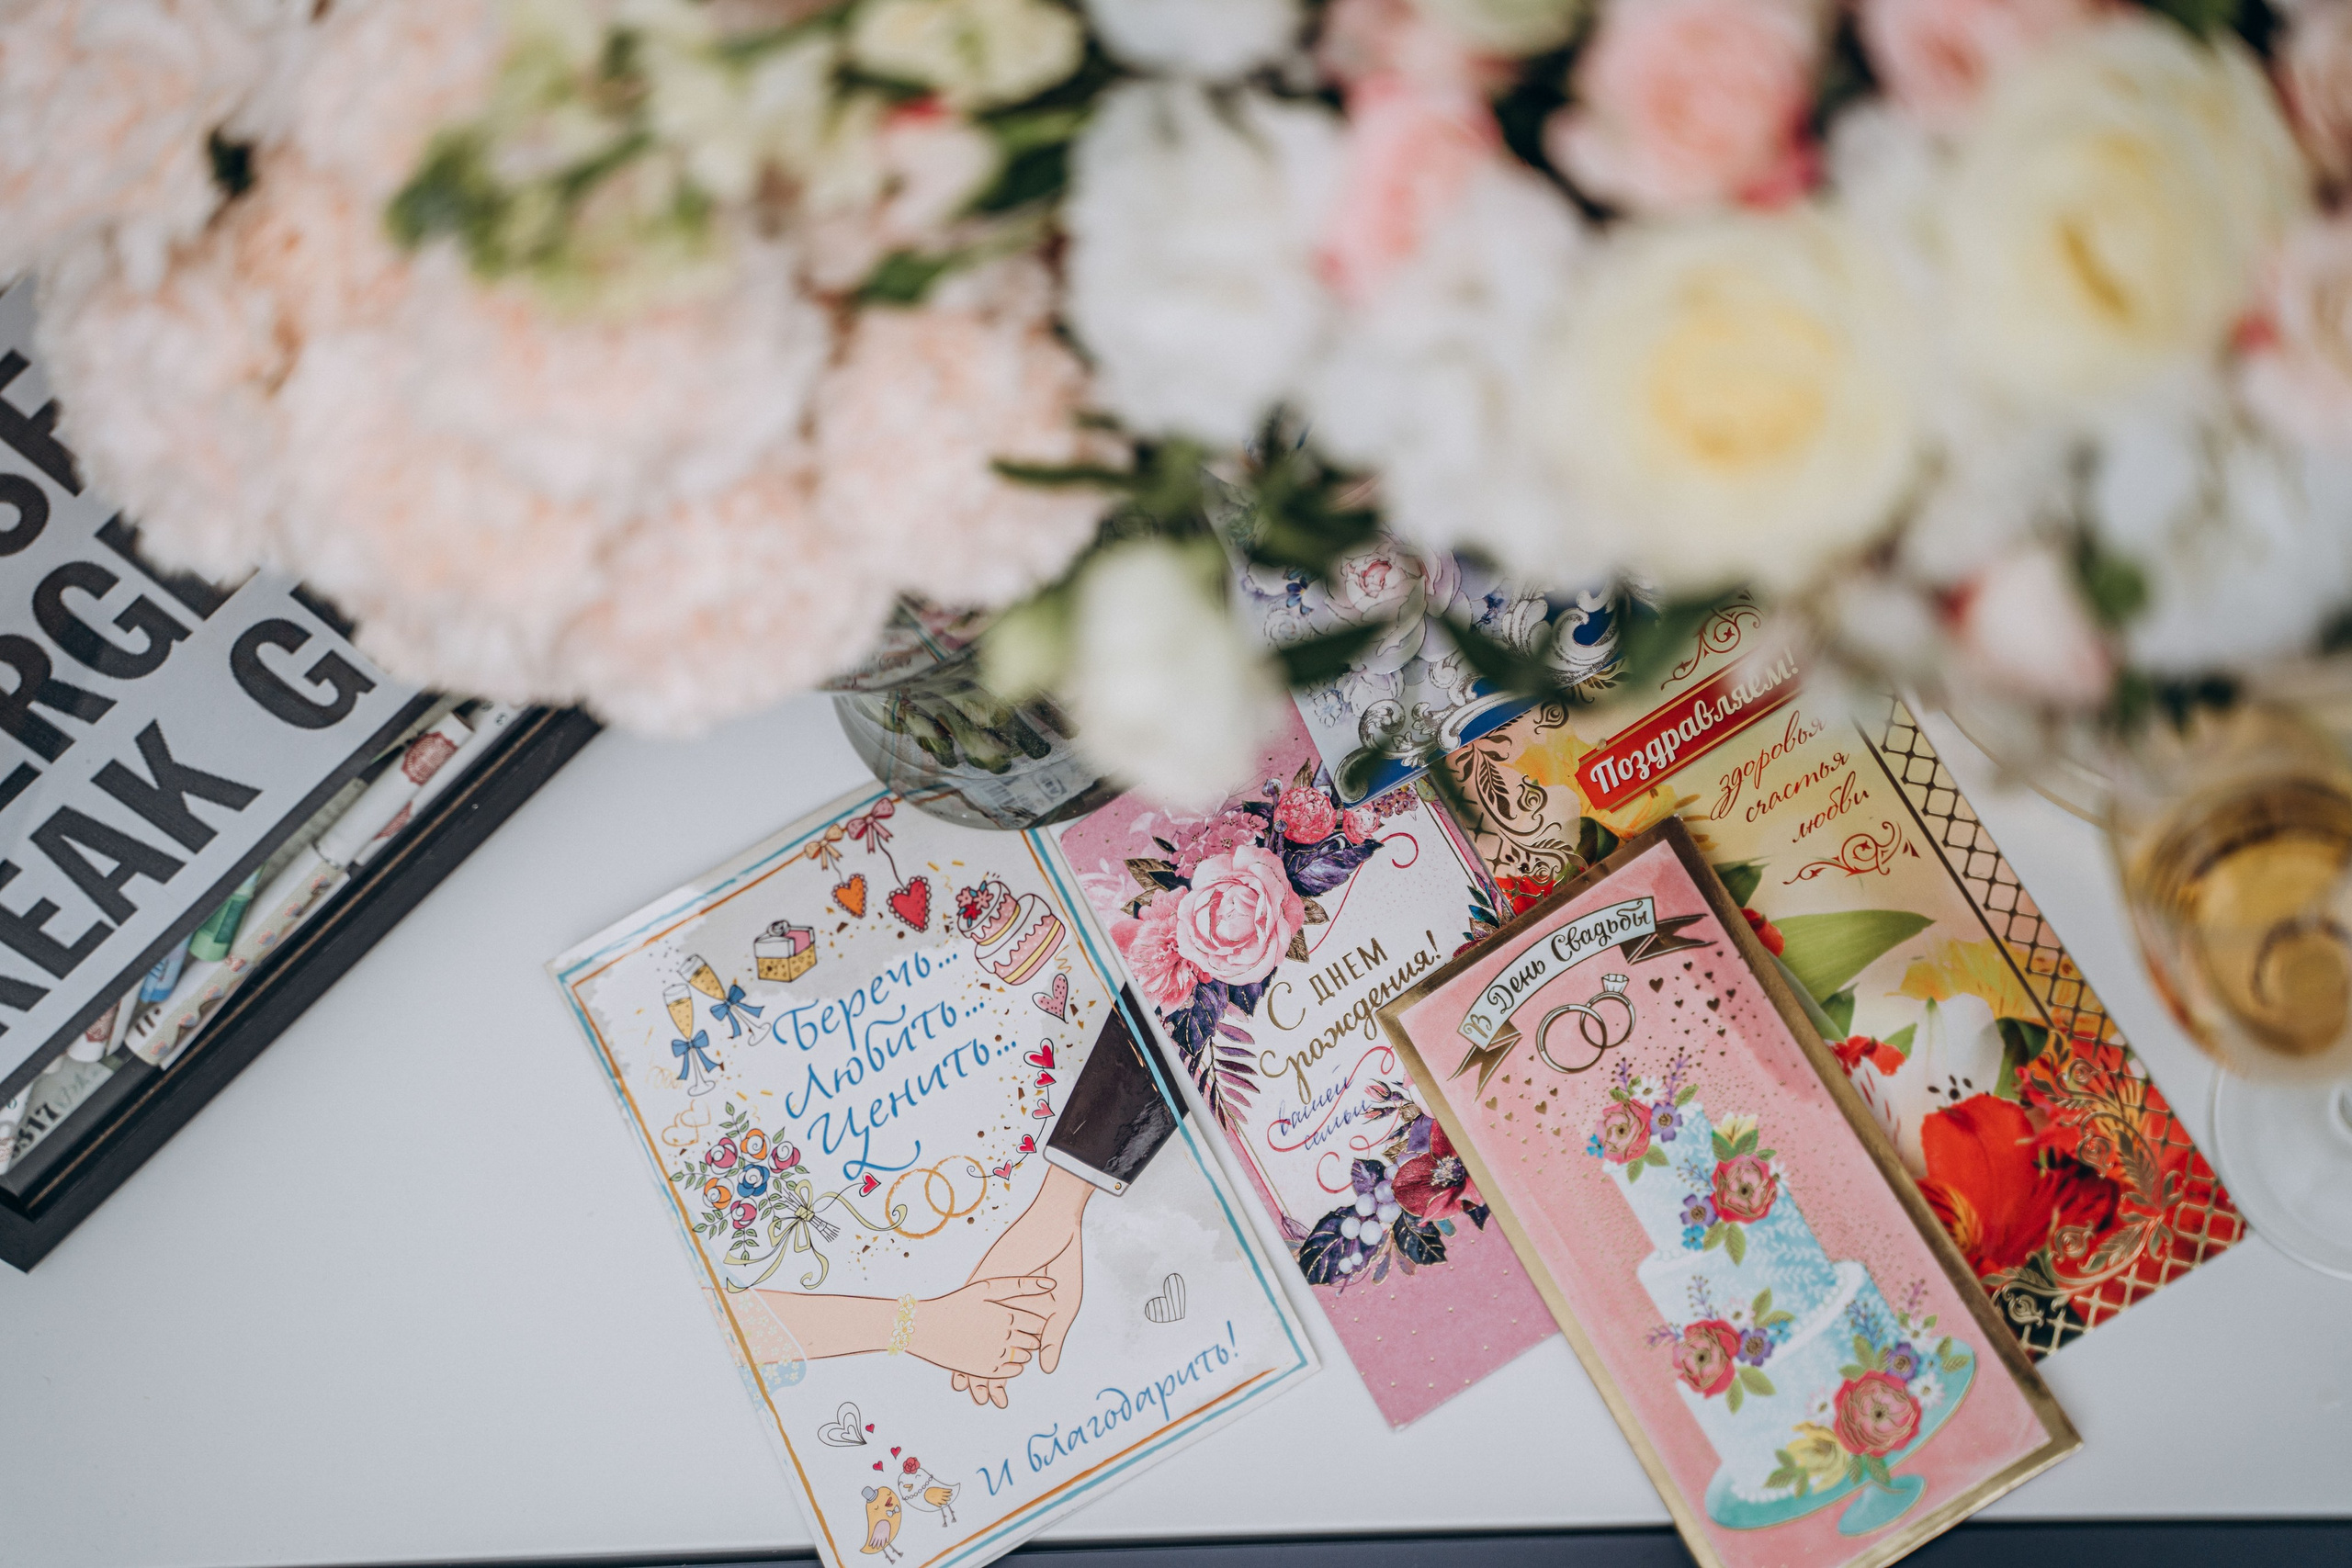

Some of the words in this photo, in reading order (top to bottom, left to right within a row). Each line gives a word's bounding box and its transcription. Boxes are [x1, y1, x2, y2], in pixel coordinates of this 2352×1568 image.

[1589, 647, 1800, 795] Поздравляем!
[1709, 709, 1826, 821] здоровья
[1746, 751, 1850, 823] счастья
[1792, 770, 1870, 843] любви
[0, 719, 264, 1037] EAK
[772, 951, 958, 1052] Беречь...
[1266, 981, 1306, 1032] С
[1307, 936, 1389, 1007] ДНЕМ
[1462, 1013, 1493, 1040] В
[1486, 959, 1546, 1015] День
[1550, 900, 1652, 963] Свадьбы
[785, 1000, 986, 1120] Любить...
[807, 1037, 1017, 1181] Ценить...
[975, 1458, 1014, 1497] И
[1026, 1319, 1239, 1472] благодарить!
